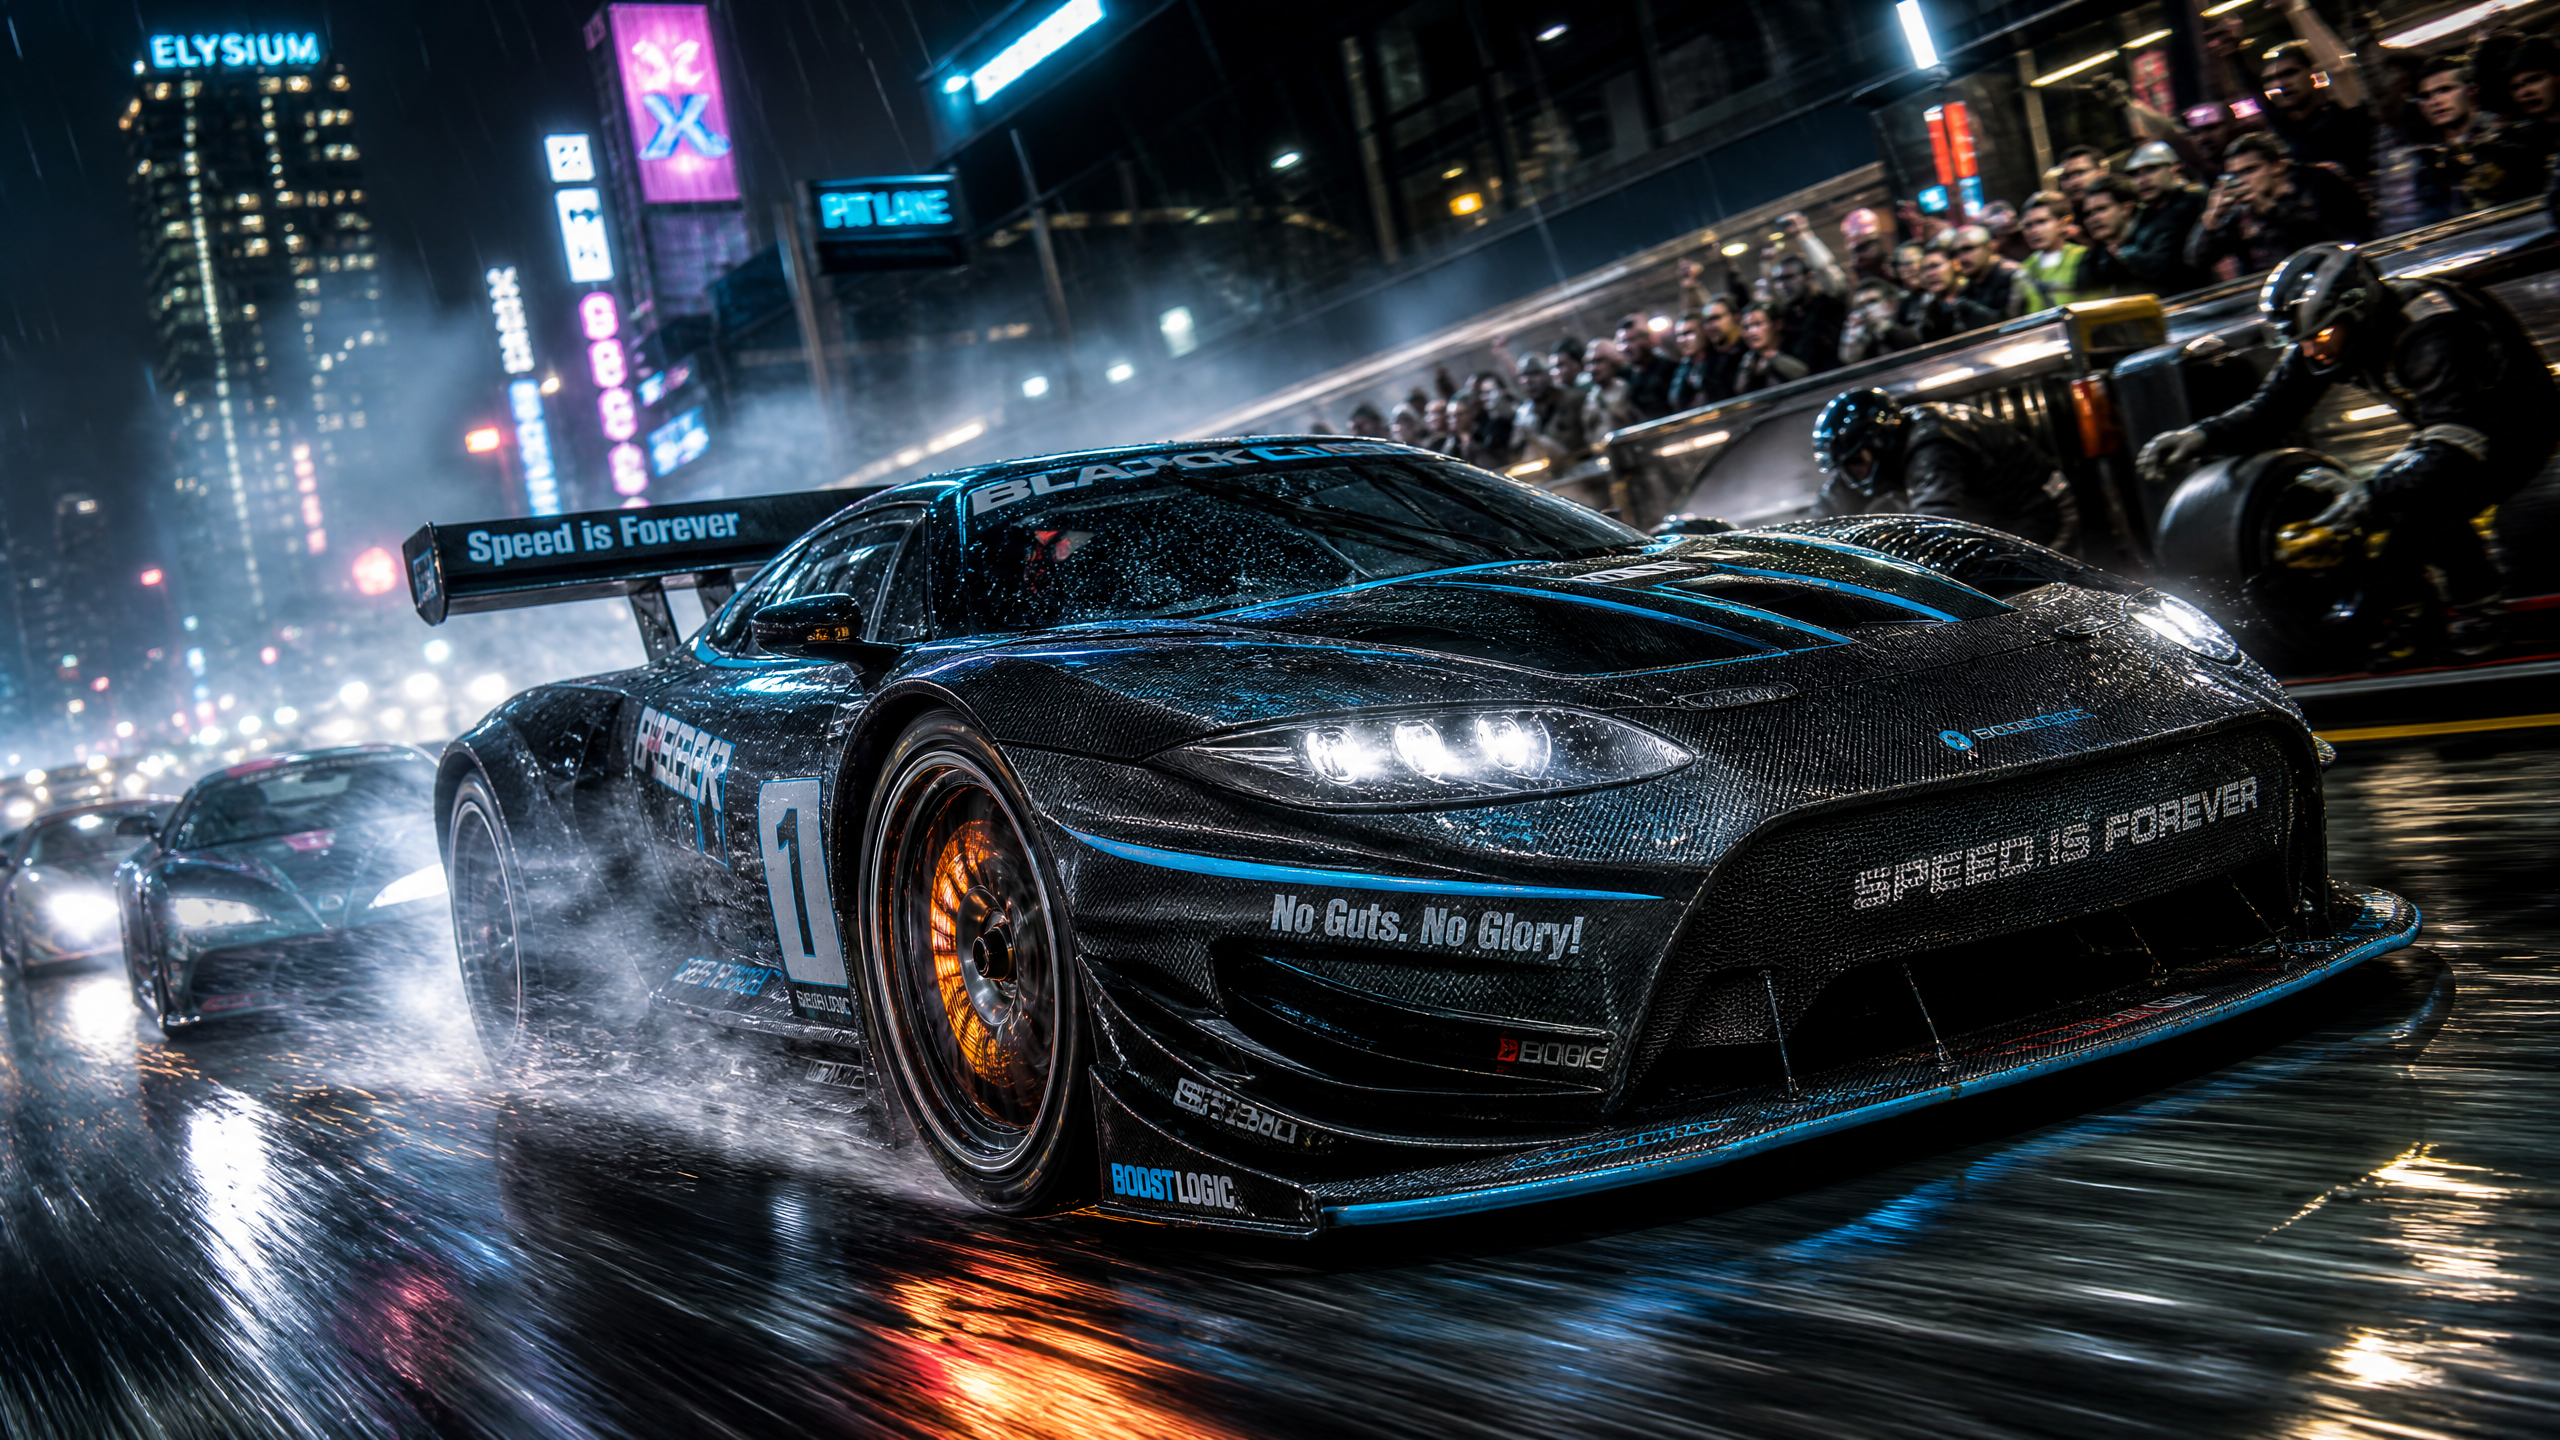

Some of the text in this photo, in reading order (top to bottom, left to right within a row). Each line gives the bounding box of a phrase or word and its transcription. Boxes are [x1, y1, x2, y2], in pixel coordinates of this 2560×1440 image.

[150, 32, 321, 68] ELYSIUM
[467, 511, 740, 567] Speed is Forever
[1854, 776, 2258, 911] SPEED IS FOREVER
[1269, 893, 1585, 961] No Guts. No Glory!
